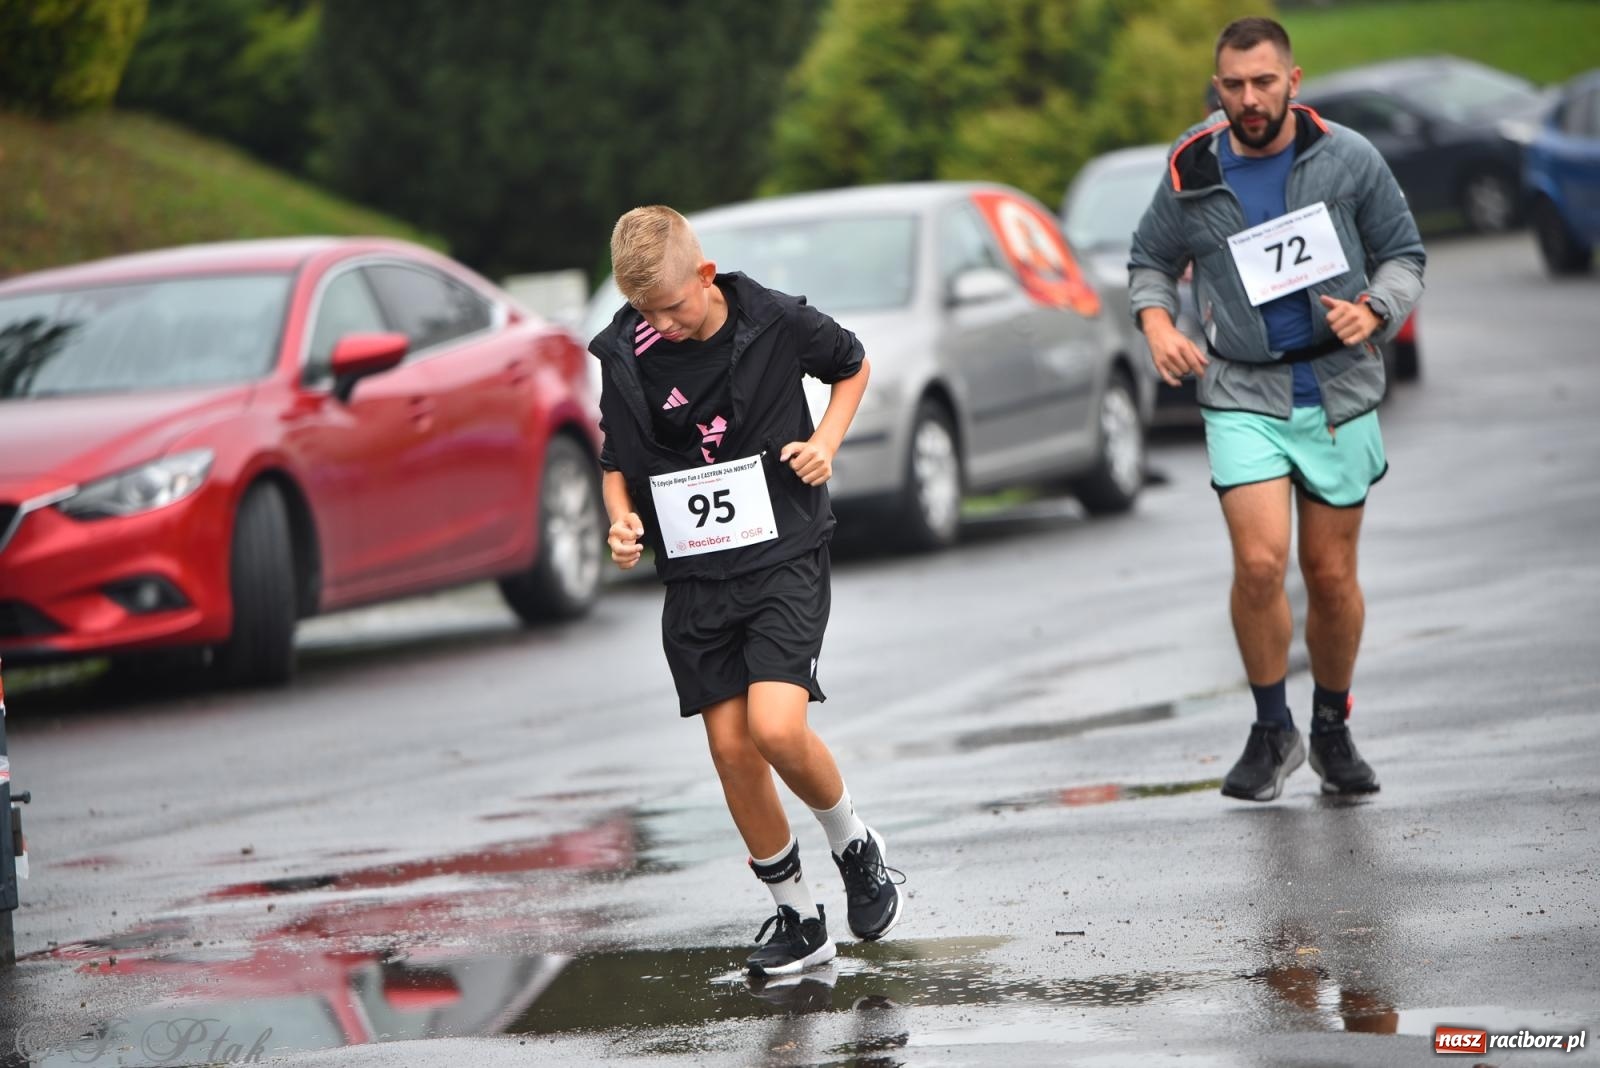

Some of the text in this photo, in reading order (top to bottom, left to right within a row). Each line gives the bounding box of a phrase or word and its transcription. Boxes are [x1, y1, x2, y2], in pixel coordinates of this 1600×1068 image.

[1264, 236, 1312, 272] 72
[657, 480, 673, 488] Edycja
[701, 469, 723, 479] EASYRUN
[723, 467, 733, 475] 24h
[688, 489, 735, 528] 95
[688, 527, 763, 549] Racibórz OSiR
